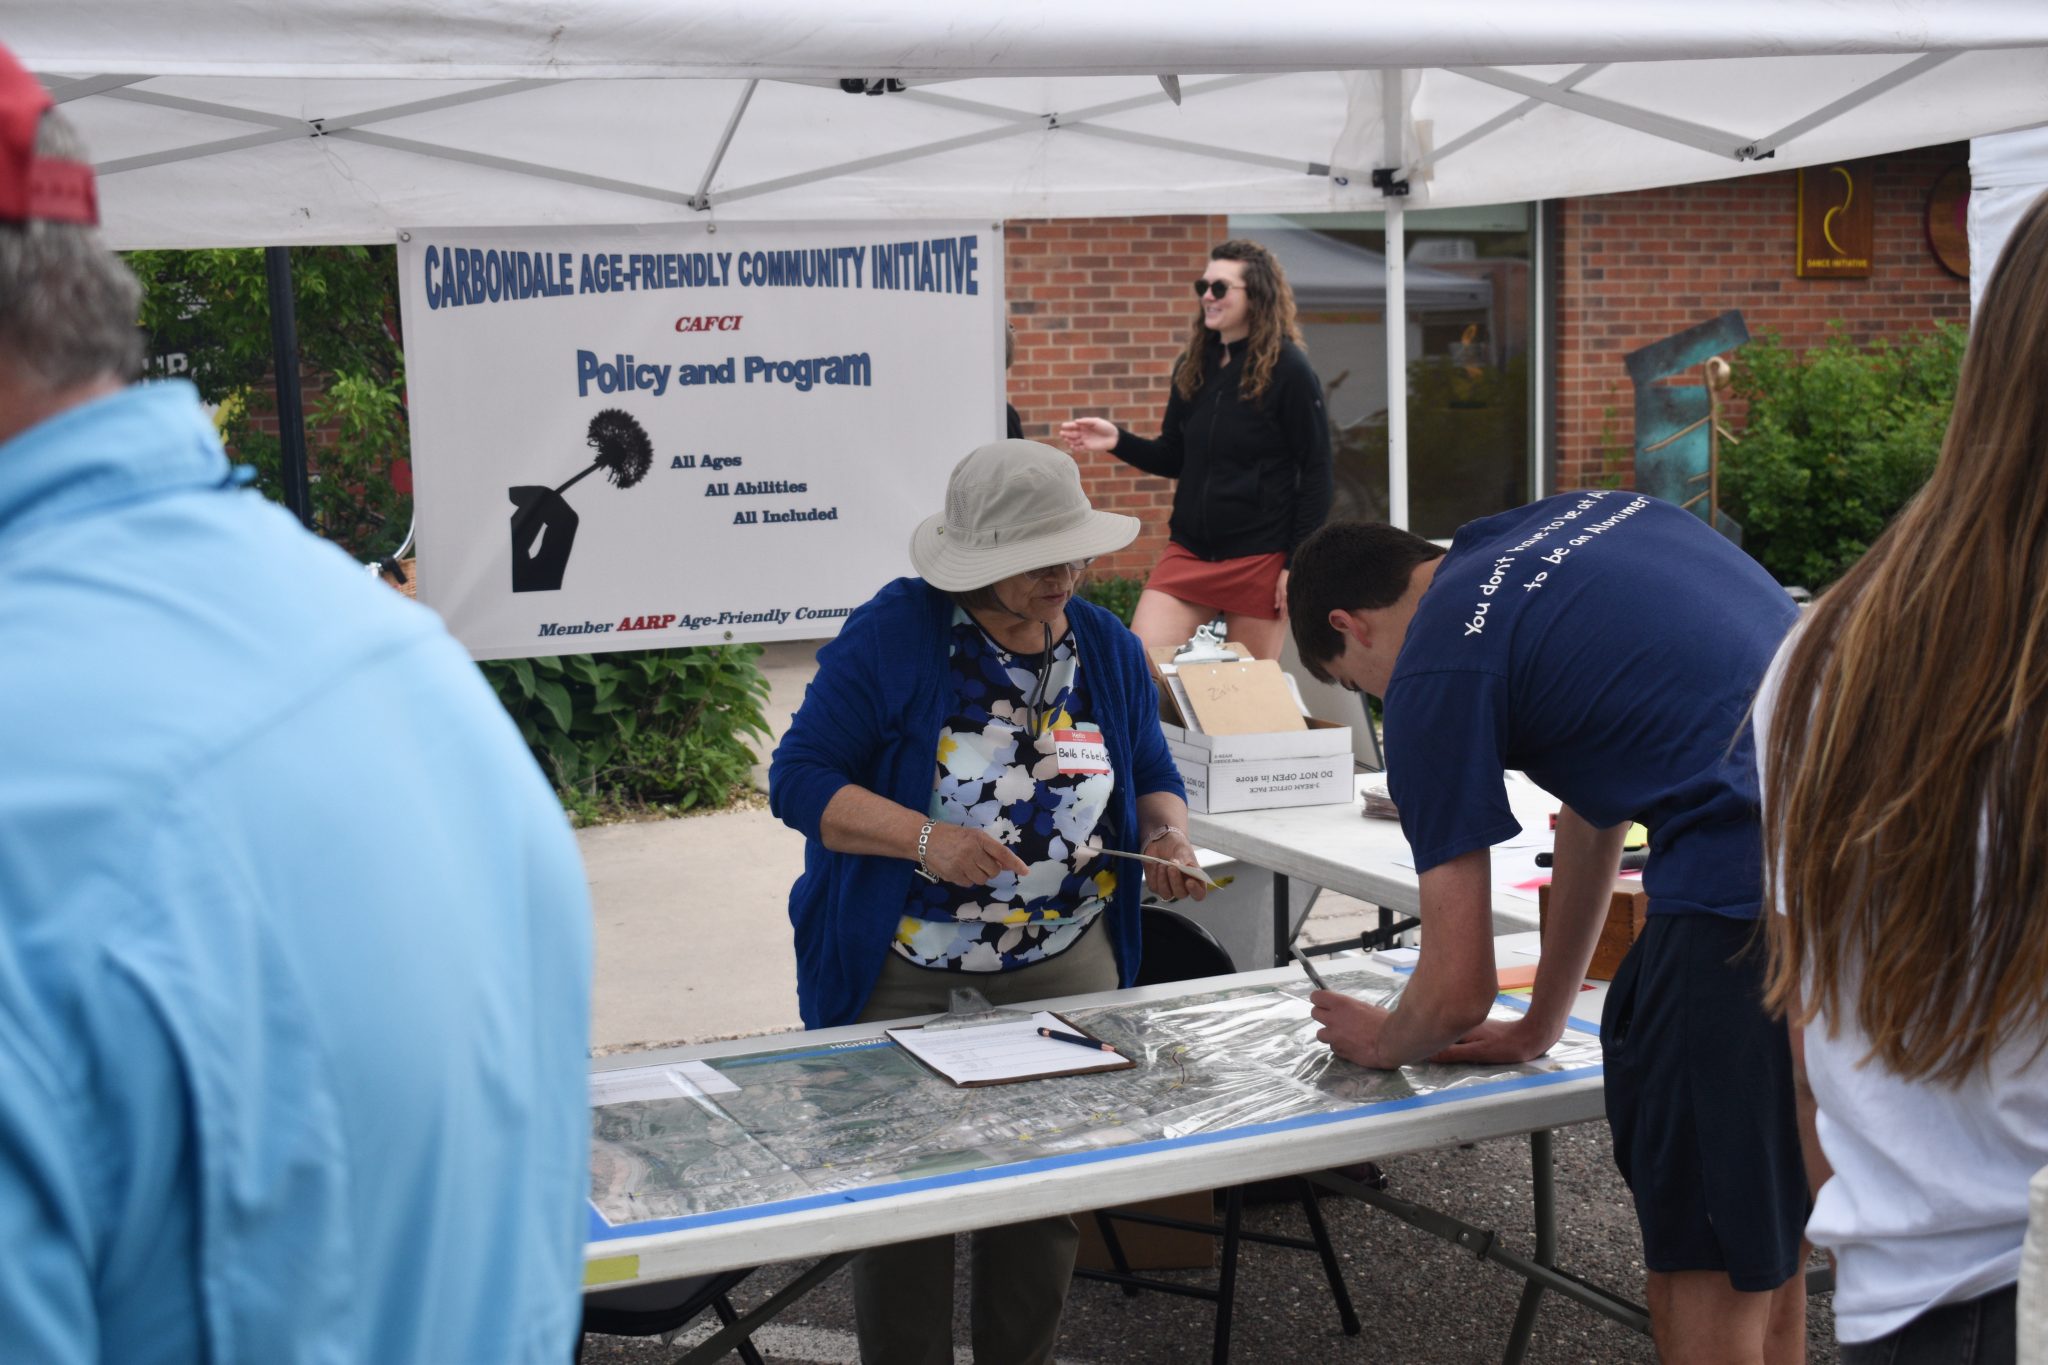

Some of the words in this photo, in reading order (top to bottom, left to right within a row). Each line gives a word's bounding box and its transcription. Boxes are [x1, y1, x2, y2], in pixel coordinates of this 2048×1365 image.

[424, 244, 575, 310] CARBONDALE
[579, 251, 733, 295] AGE-FRIENDLY
[738, 246, 867, 289] COMMUNITY
[871, 235, 979, 296] INITIATIVE
[674, 314, 744, 333] CAFCI
[577, 349, 672, 397] Policy
[679, 357, 736, 386] and
[744, 352, 872, 391] Program
[670, 455, 696, 469] All
[700, 454, 742, 470] Ages
[704, 483, 730, 497] All
[734, 480, 808, 496] Abilities
[732, 511, 758, 525] All
[762, 507, 838, 523] Included
[1464, 602, 1491, 636] You
[1479, 556, 1515, 596] don't
[1505, 530, 1549, 553] have
[1540, 519, 1565, 533] to
[1554, 510, 1583, 520] be
[1577, 499, 1598, 510] at
[1523, 571, 1548, 592] to
[1540, 547, 1571, 564] be
[1568, 534, 1593, 547] an
[538, 619, 614, 637] Member
[616, 614, 677, 632] AARP
[678, 607, 791, 631] Age-Friendly
[1235, 775, 1259, 783] store
[1261, 774, 1271, 782] in
[1272, 773, 1297, 782] OPEN
[1299, 771, 1318, 780] NOT
[1320, 770, 1333, 778] DO
[1249, 786, 1267, 794] PACK
[1270, 784, 1293, 792] OFFICE
